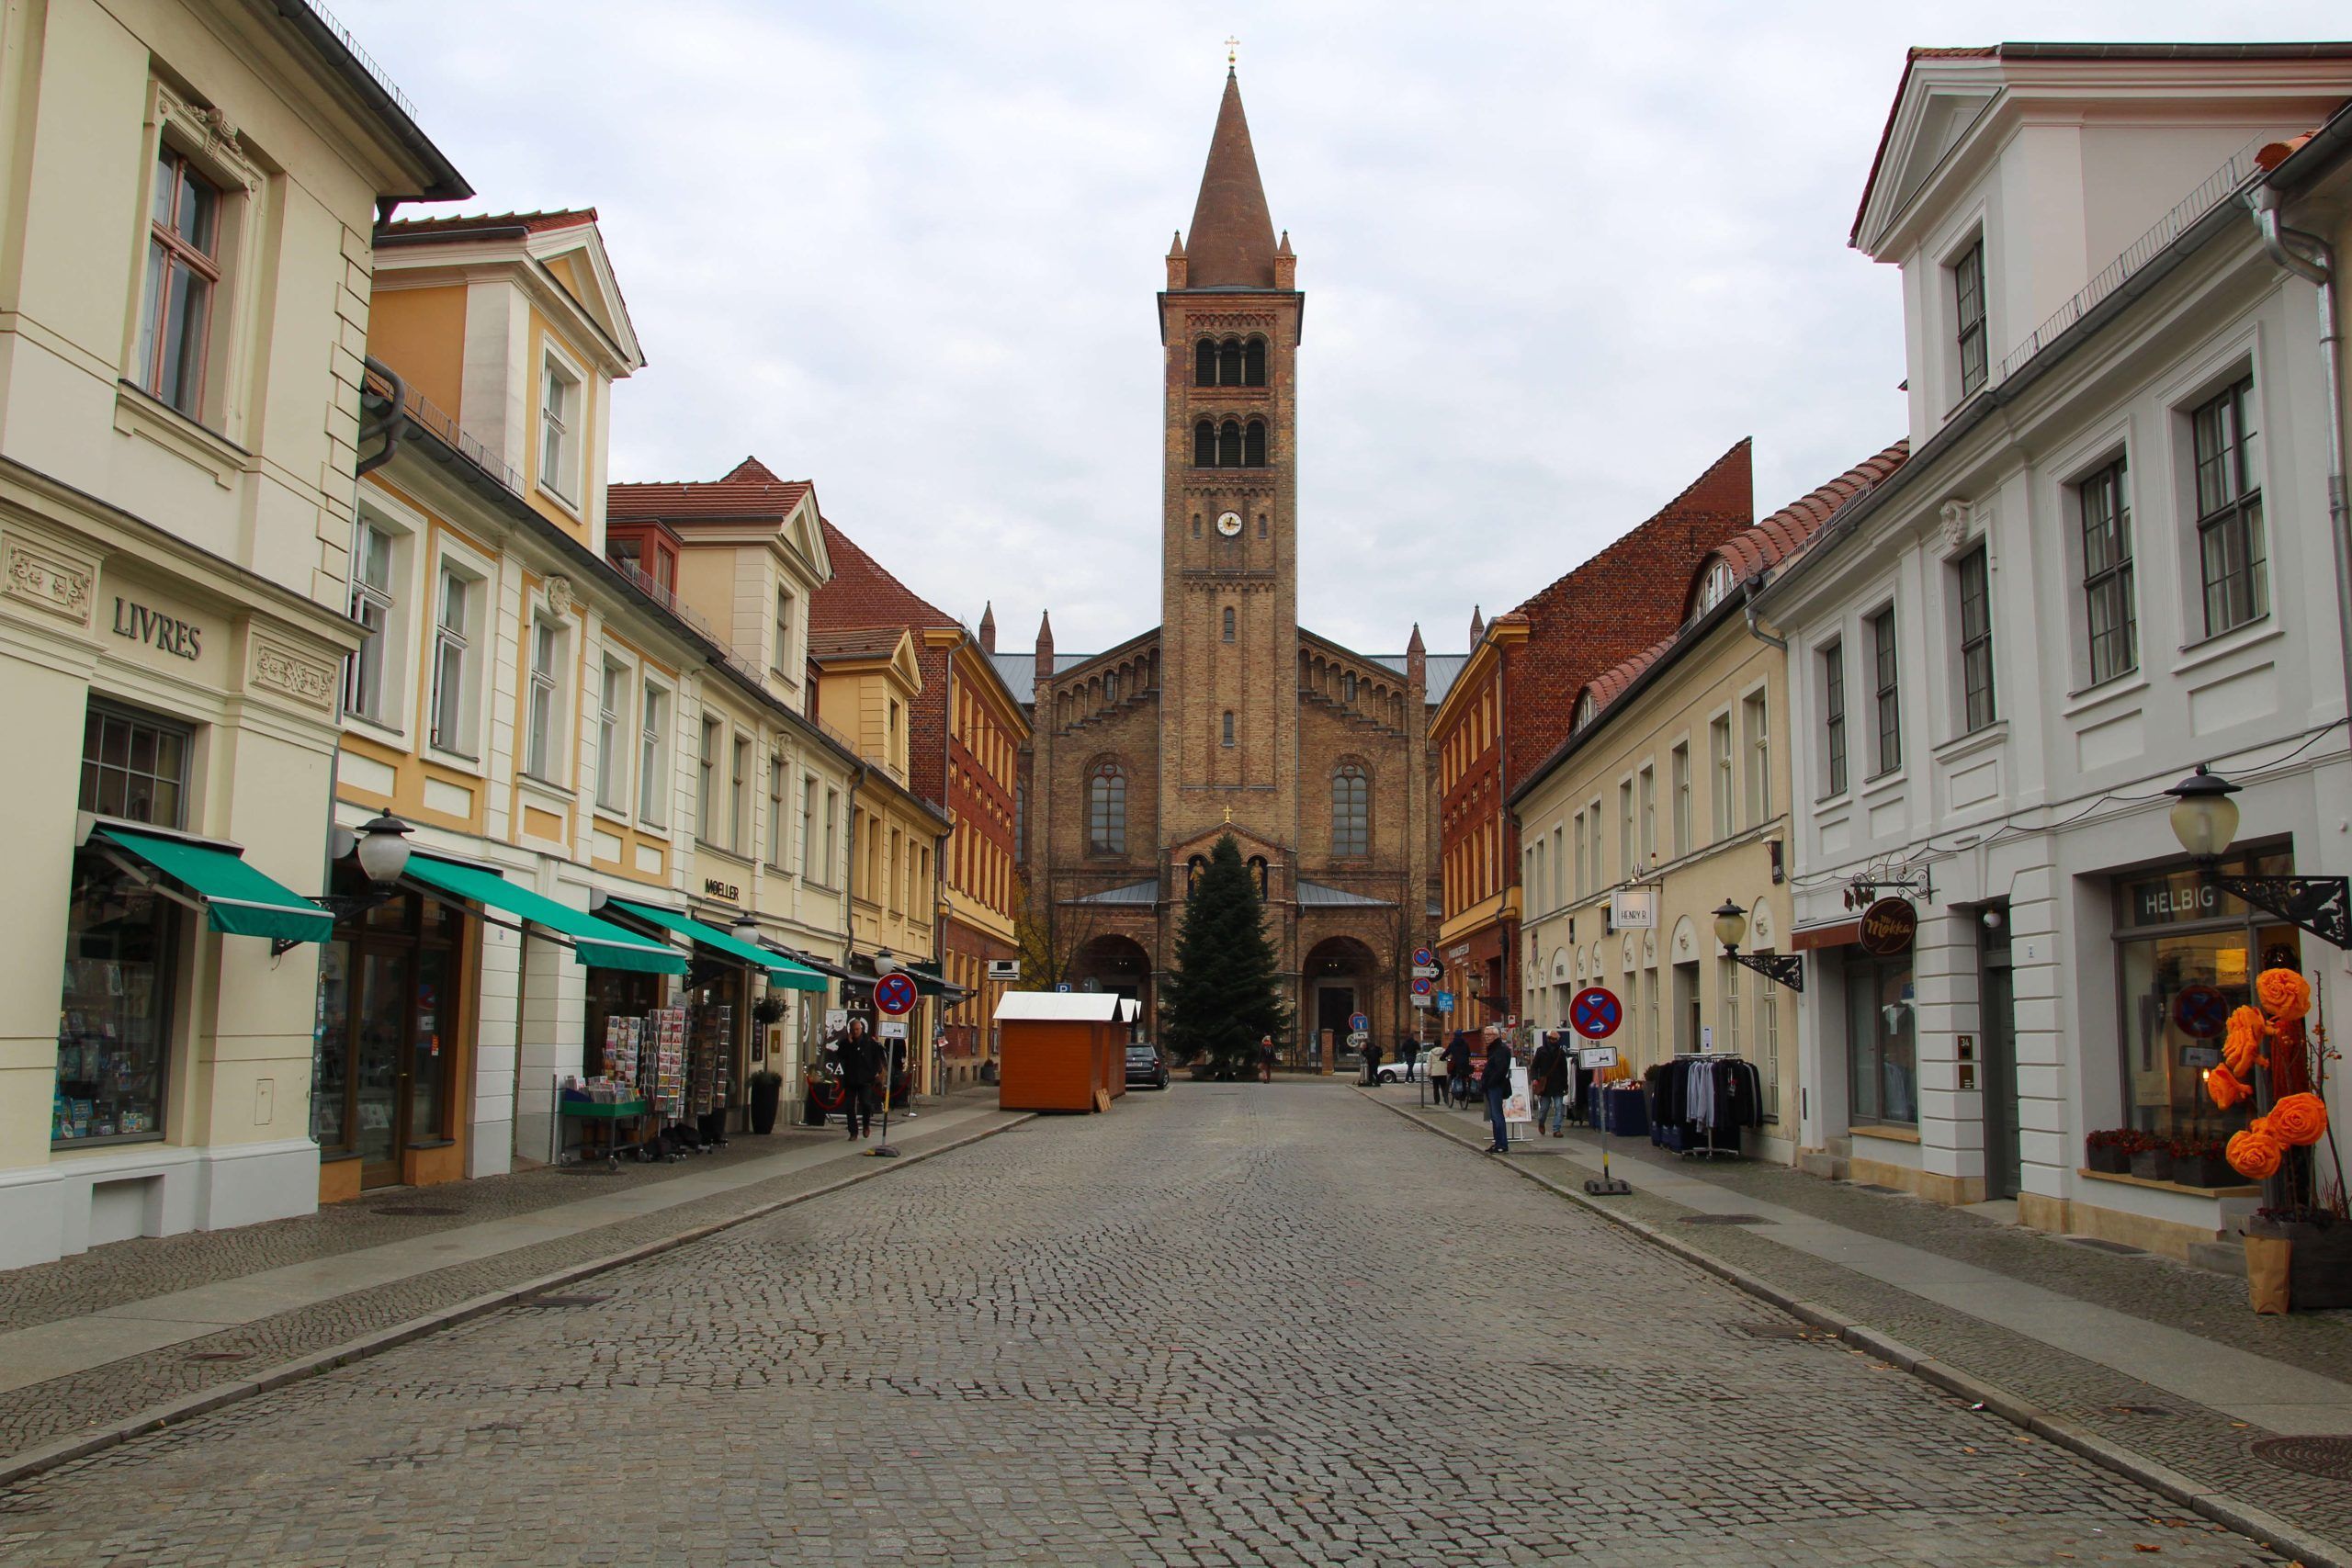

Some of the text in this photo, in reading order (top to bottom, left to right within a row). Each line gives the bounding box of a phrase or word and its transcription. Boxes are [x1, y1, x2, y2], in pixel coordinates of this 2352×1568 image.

[113, 596, 202, 660] LIVRES
[705, 878, 740, 901] MOELLER
[2145, 886, 2214, 915] HELBIG
[1621, 910, 1641, 919] HENRY
[1866, 919, 1912, 939] Mokka
[1961, 1038, 1970, 1047] 34
